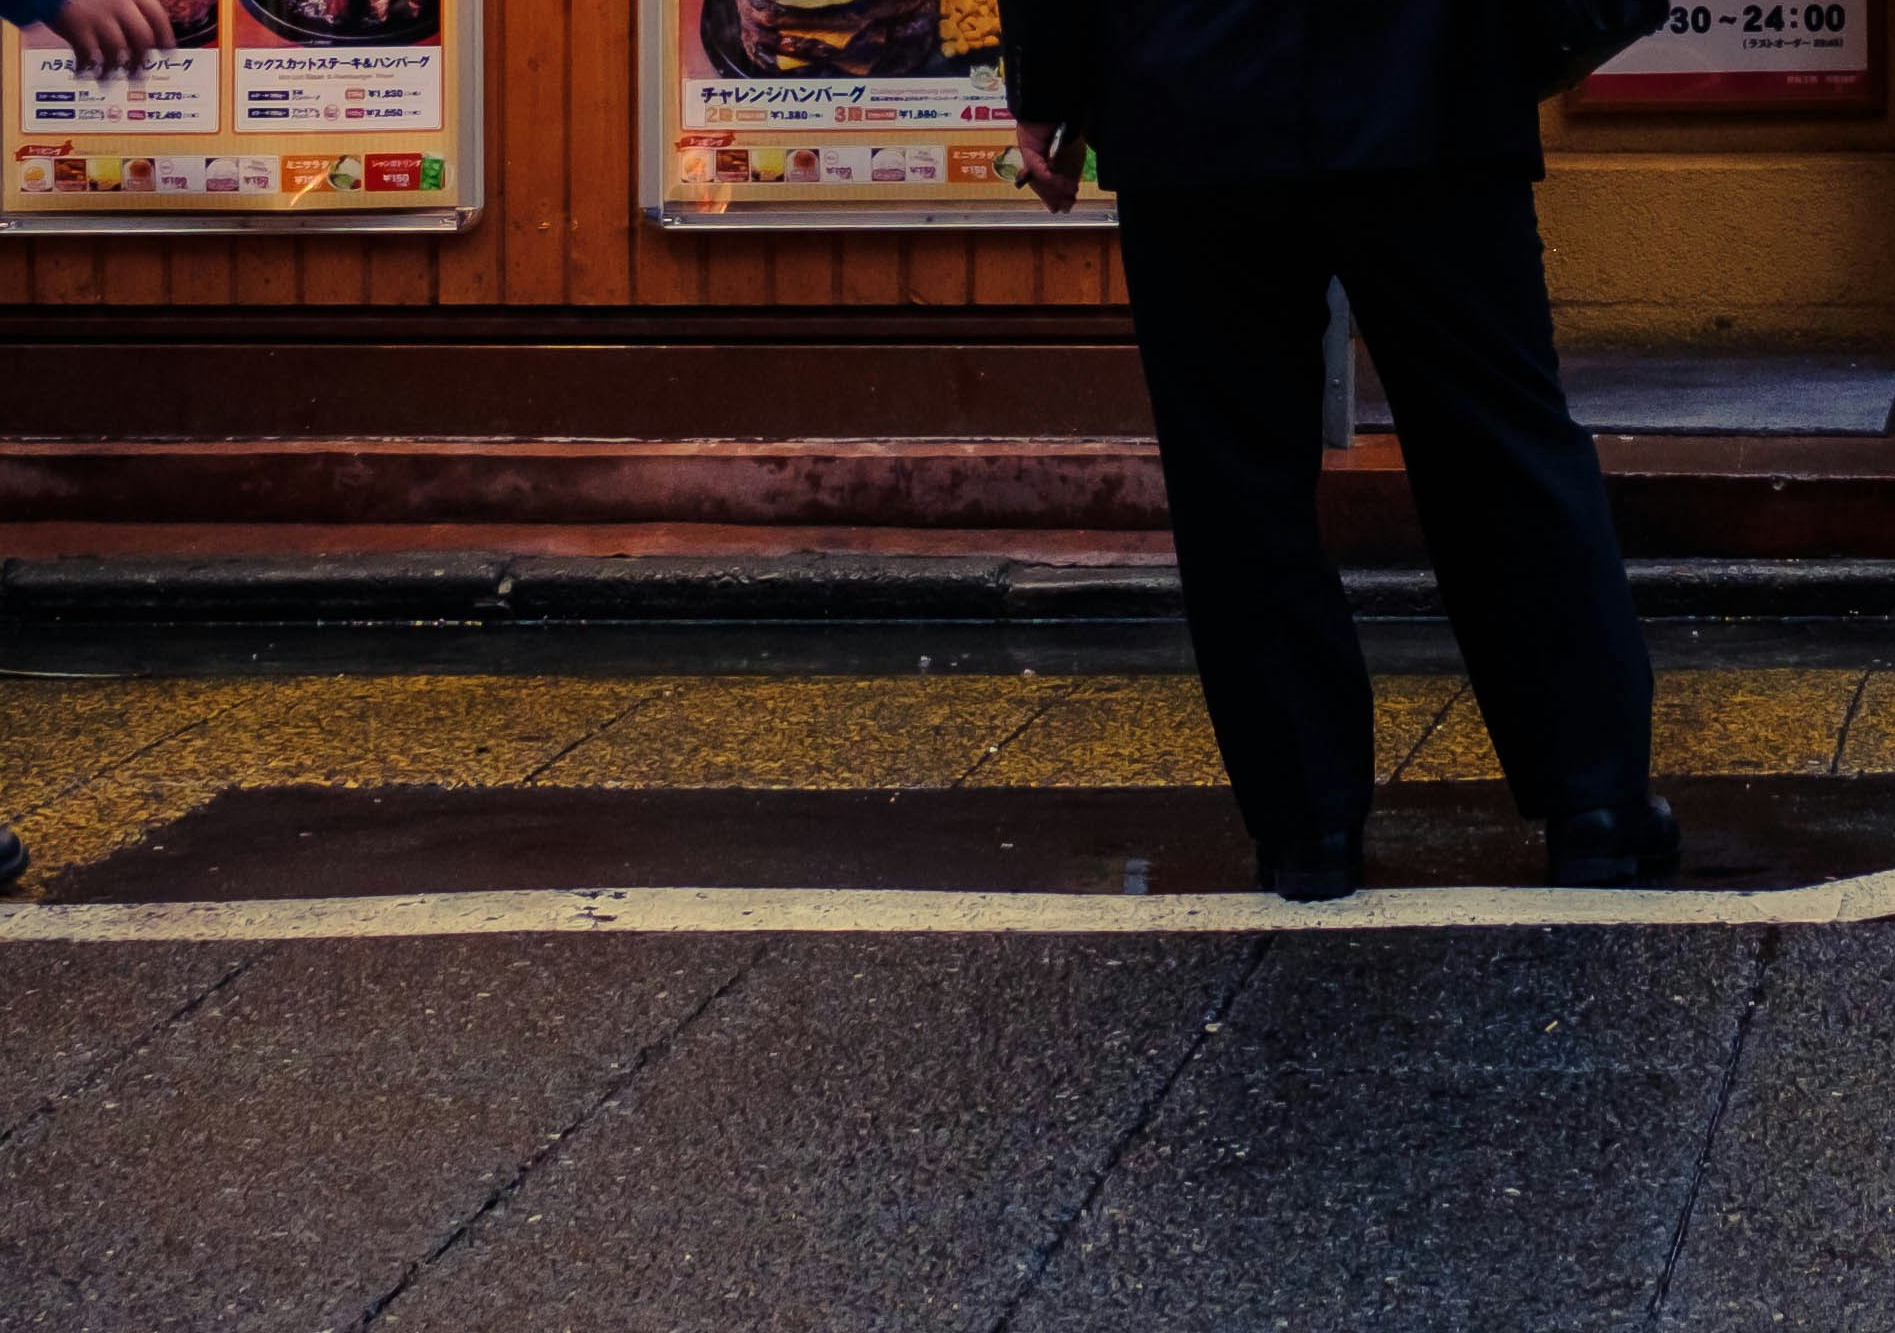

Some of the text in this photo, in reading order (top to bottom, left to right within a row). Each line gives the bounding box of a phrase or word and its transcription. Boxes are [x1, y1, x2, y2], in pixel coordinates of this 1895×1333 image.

[701, 85, 867, 105] チャレンジハンバーグ
